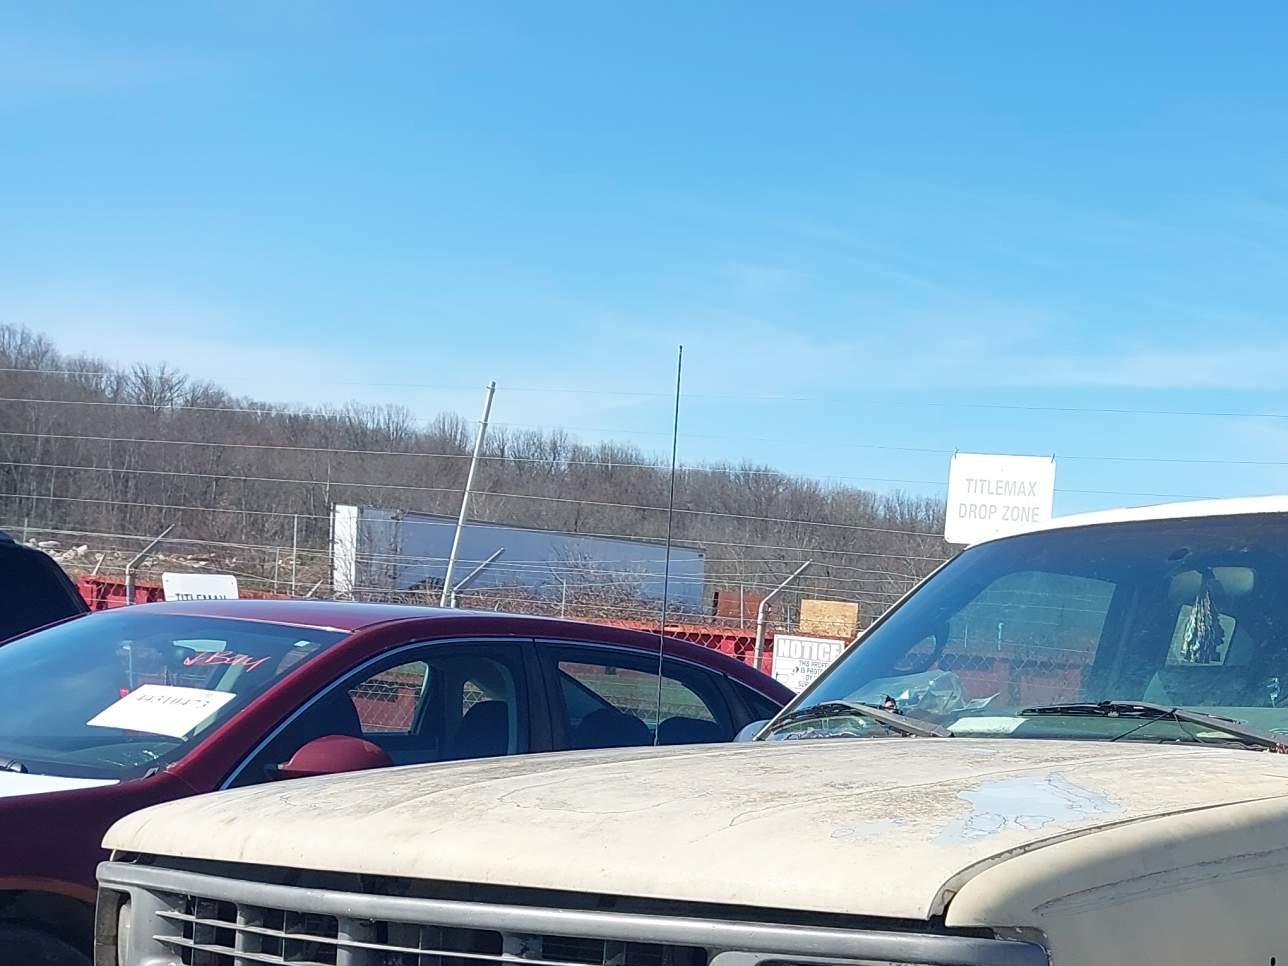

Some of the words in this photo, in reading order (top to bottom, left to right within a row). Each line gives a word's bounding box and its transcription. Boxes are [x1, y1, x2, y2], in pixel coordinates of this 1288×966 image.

[965, 478, 1038, 497] TITLEMAX
[958, 503, 998, 520] DROP
[1001, 505, 1041, 523] ZONE
[776, 637, 842, 662] NOTICE
